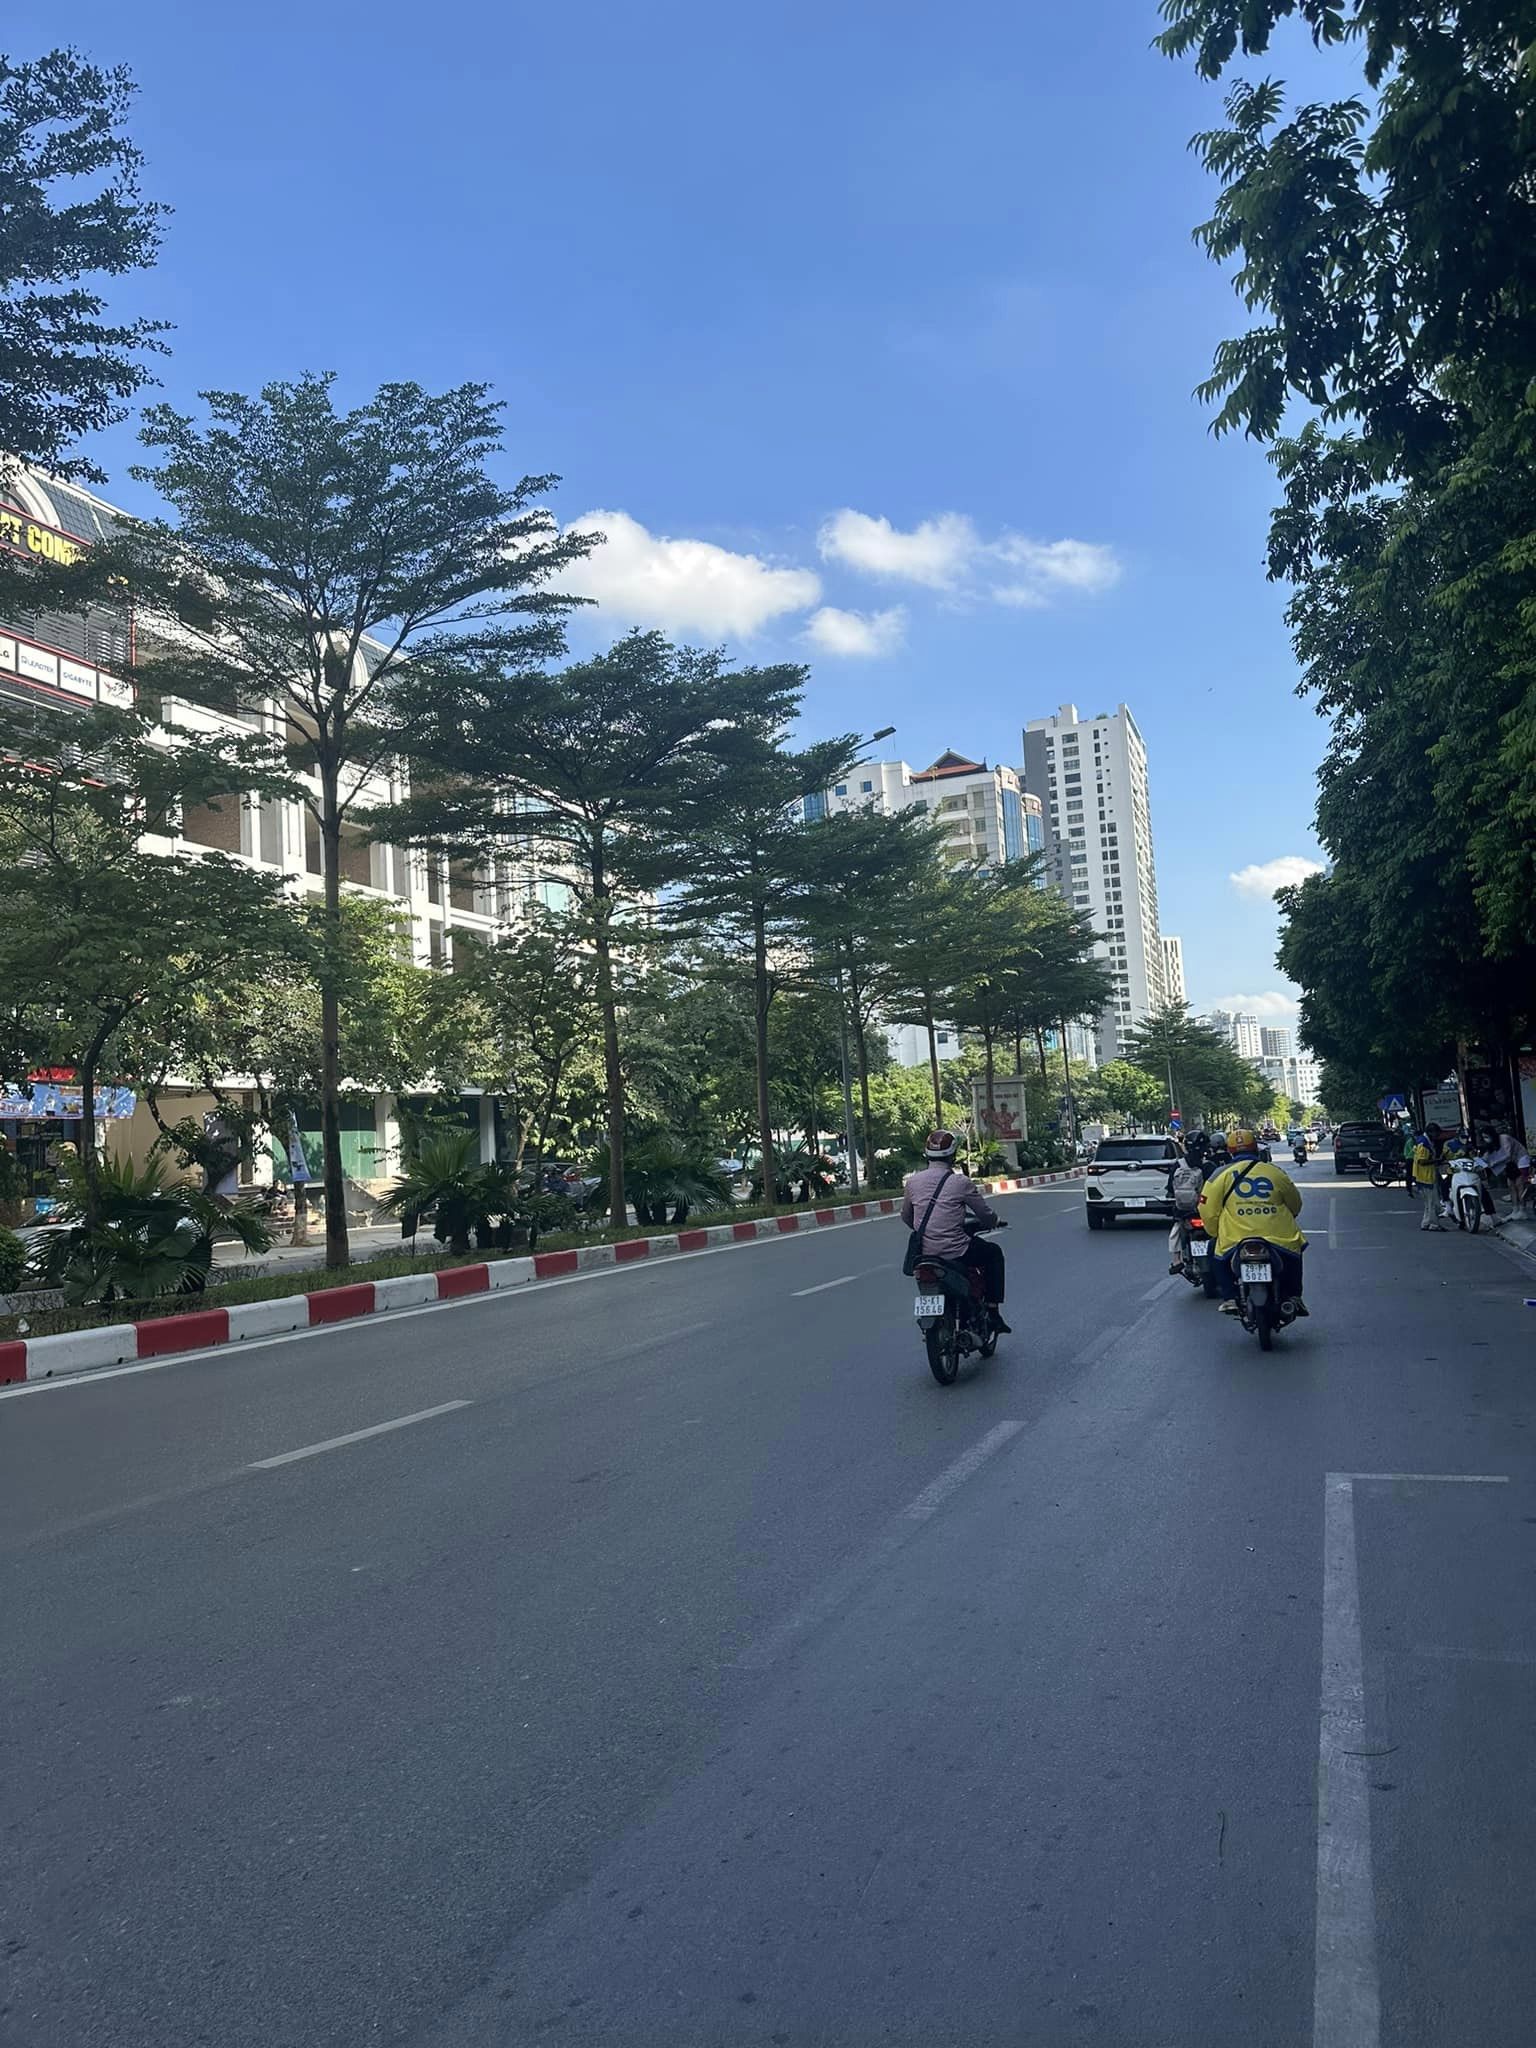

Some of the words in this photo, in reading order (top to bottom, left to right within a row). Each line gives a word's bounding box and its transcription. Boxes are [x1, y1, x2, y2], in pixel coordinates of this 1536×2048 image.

[63, 672, 92, 687] GIGABYTE
[1232, 1170, 1274, 1199] be
[1245, 1272, 1268, 1281] 5021
